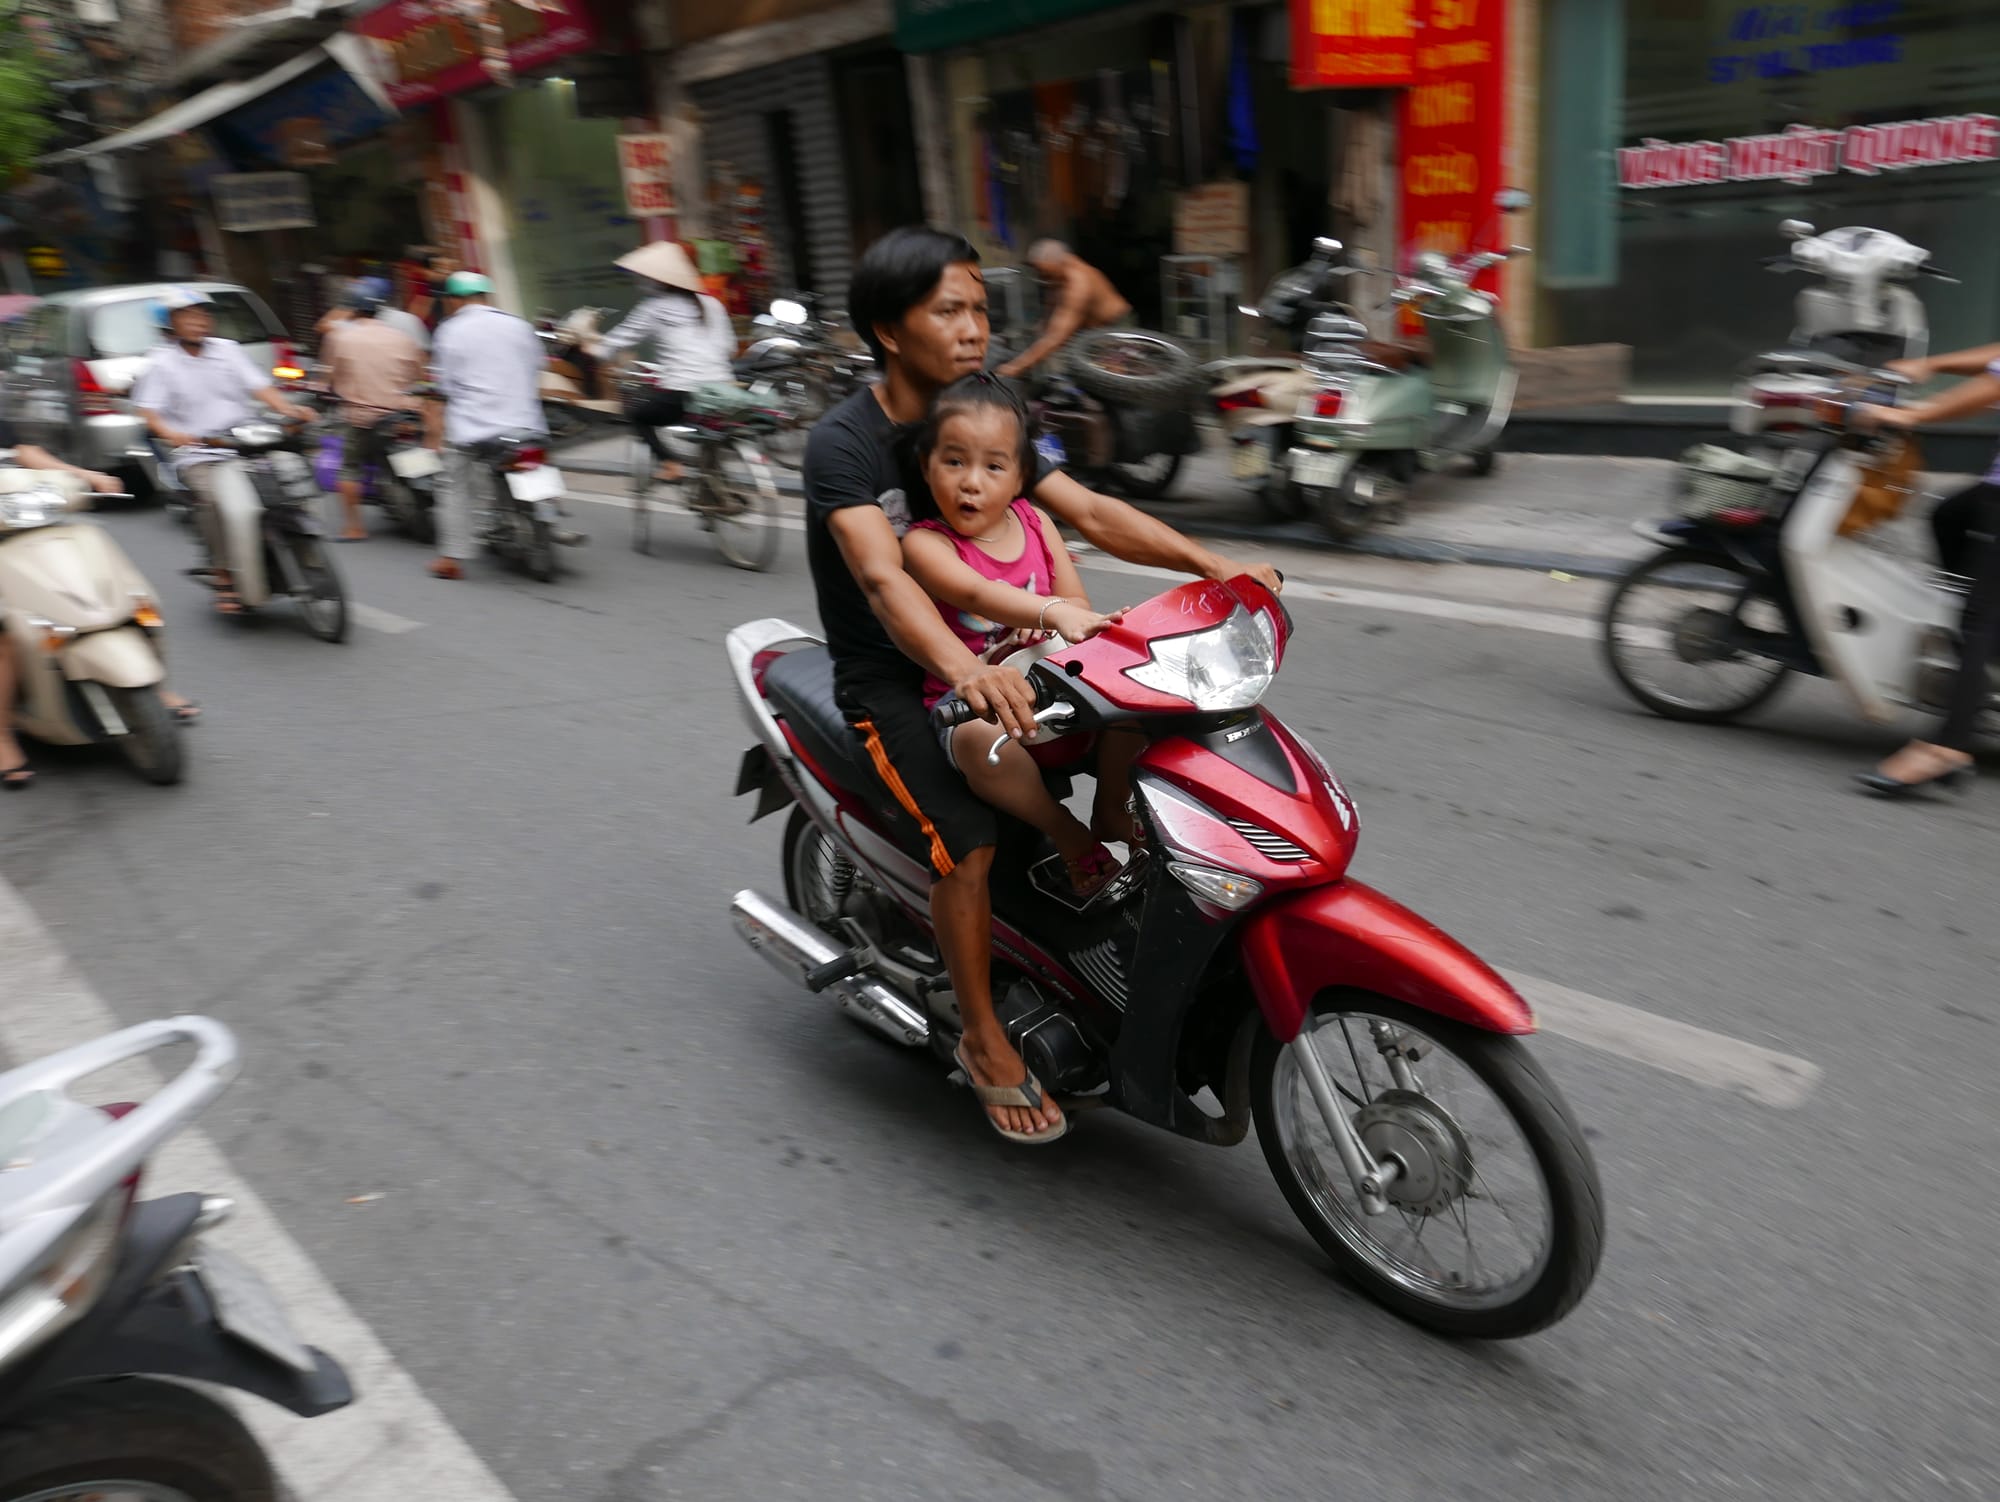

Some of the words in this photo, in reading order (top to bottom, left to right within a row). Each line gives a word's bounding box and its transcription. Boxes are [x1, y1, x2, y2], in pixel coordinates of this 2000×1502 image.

[1616, 138, 1727, 188] VÀNG
[1724, 124, 1845, 185] NHẬT
[1842, 113, 2000, 176] QUANG
[1225, 721, 1264, 743] HON
